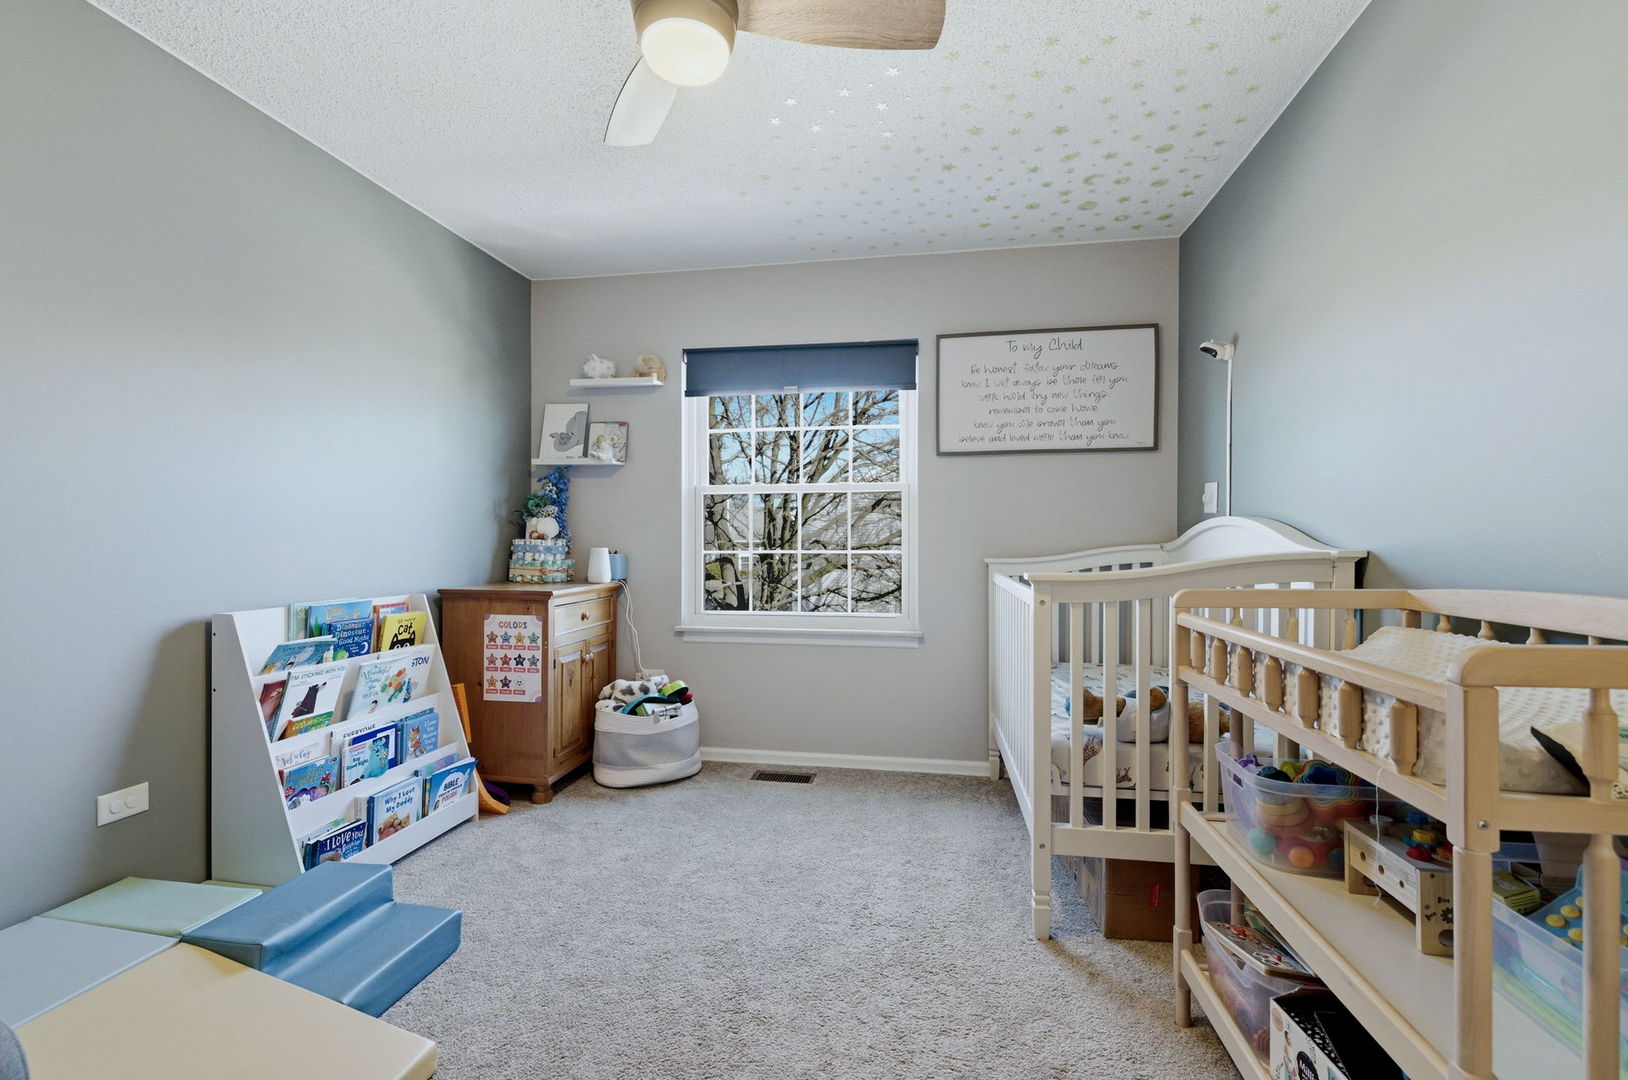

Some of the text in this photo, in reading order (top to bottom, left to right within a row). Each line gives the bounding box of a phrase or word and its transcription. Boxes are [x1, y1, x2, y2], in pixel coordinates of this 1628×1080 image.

[1005, 337, 1083, 360] To my Child
[1052, 362, 1076, 378] your
[1079, 360, 1119, 372] dreams
[985, 378, 991, 388] I
[1012, 378, 1041, 393] always
[1047, 376, 1057, 386] be
[1062, 375, 1087, 386] there
[1092, 375, 1106, 385] for
[1108, 375, 1128, 390] you
[1031, 391, 1048, 406] try
[1073, 388, 1108, 403] things
[1033, 404, 1044, 414] to
[1046, 404, 1068, 414] come
[1071, 403, 1098, 413] home
[996, 421, 1015, 435] you
[1070, 416, 1094, 428] than
[1096, 418, 1116, 433] you
[988, 433, 1007, 443] and
[1009, 433, 1030, 442] loved
[1059, 431, 1083, 442] than
[1085, 433, 1105, 447] you
[498, 621, 528, 630] COLORS
[443, 777, 460, 792] BIBLE
[384, 797, 397, 806] Why
[385, 797, 414, 813] My Daddy
